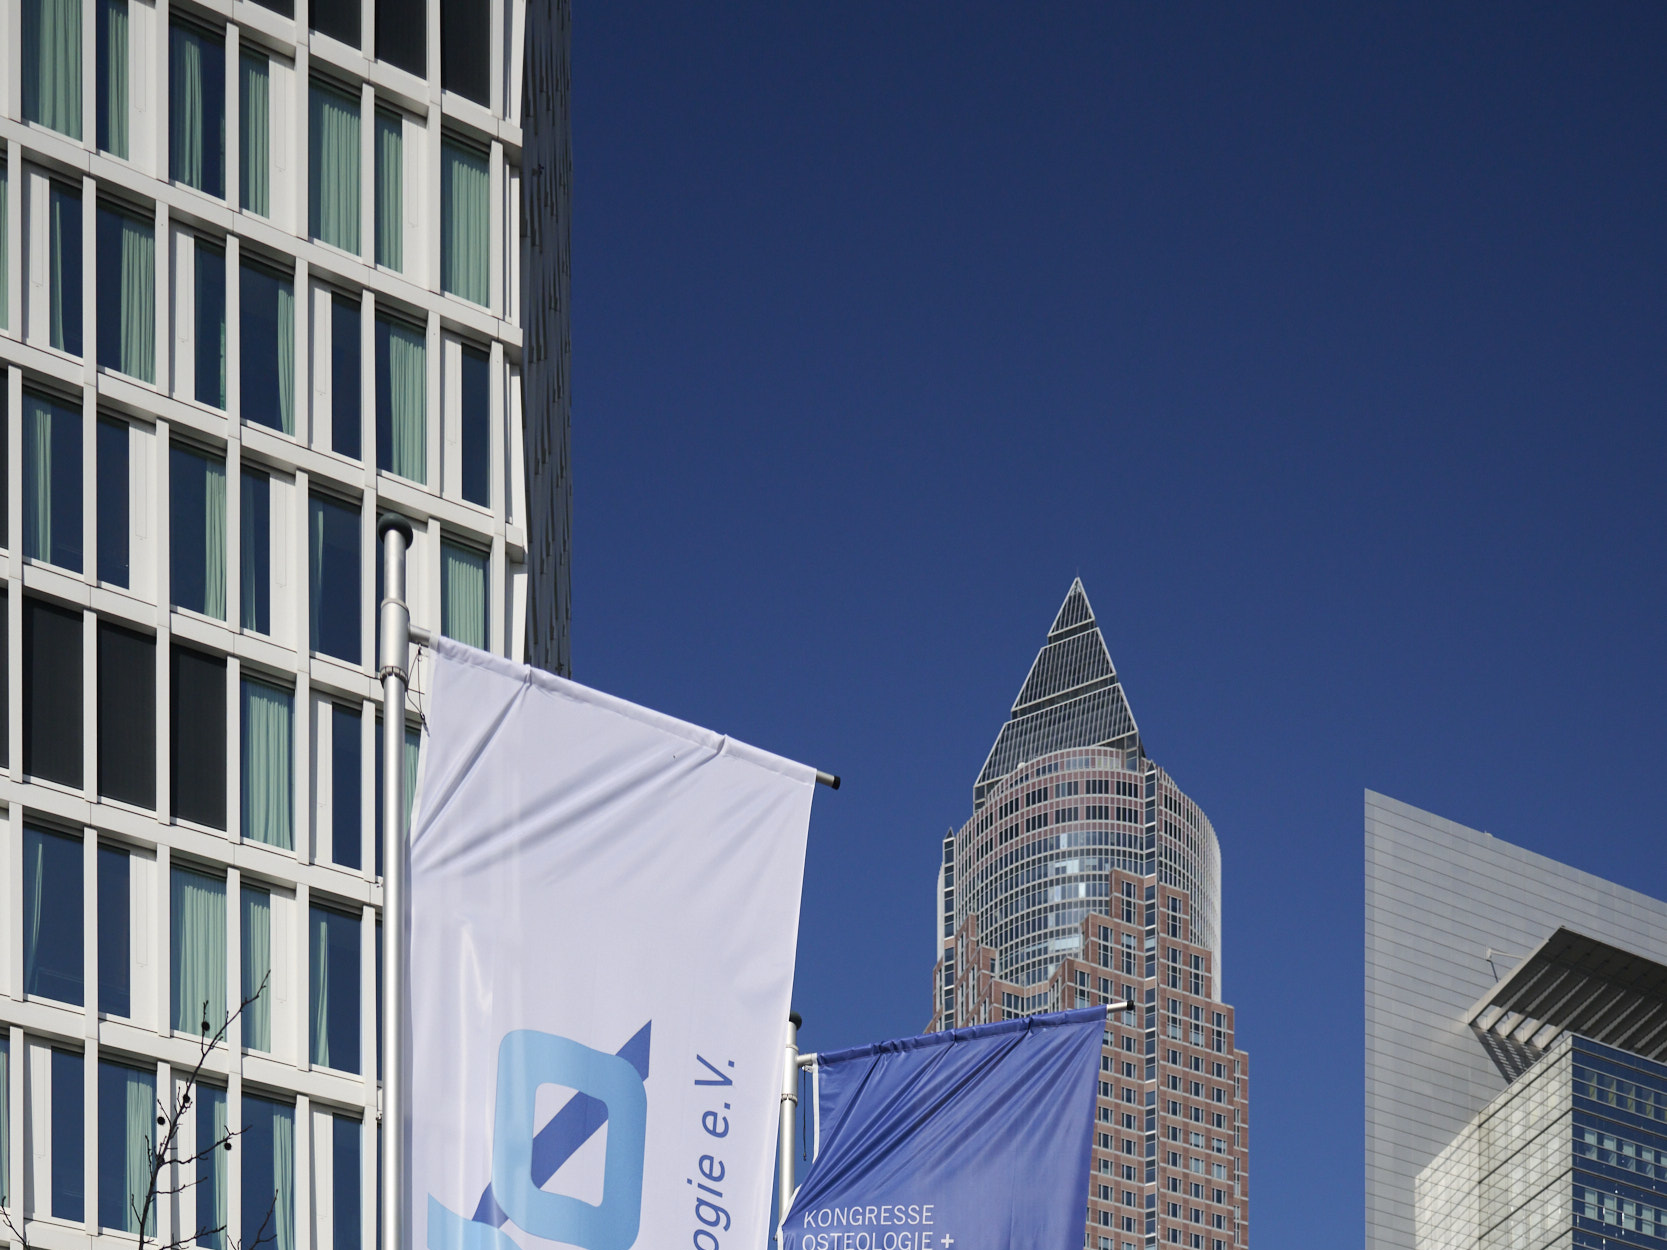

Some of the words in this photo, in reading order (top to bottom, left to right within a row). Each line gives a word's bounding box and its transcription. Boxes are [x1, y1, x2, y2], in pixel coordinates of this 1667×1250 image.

[694, 1054, 735, 1087] V.
[701, 1102, 731, 1138] e.
[803, 1205, 935, 1229] KONGRESSE
[940, 1233, 955, 1249] +
